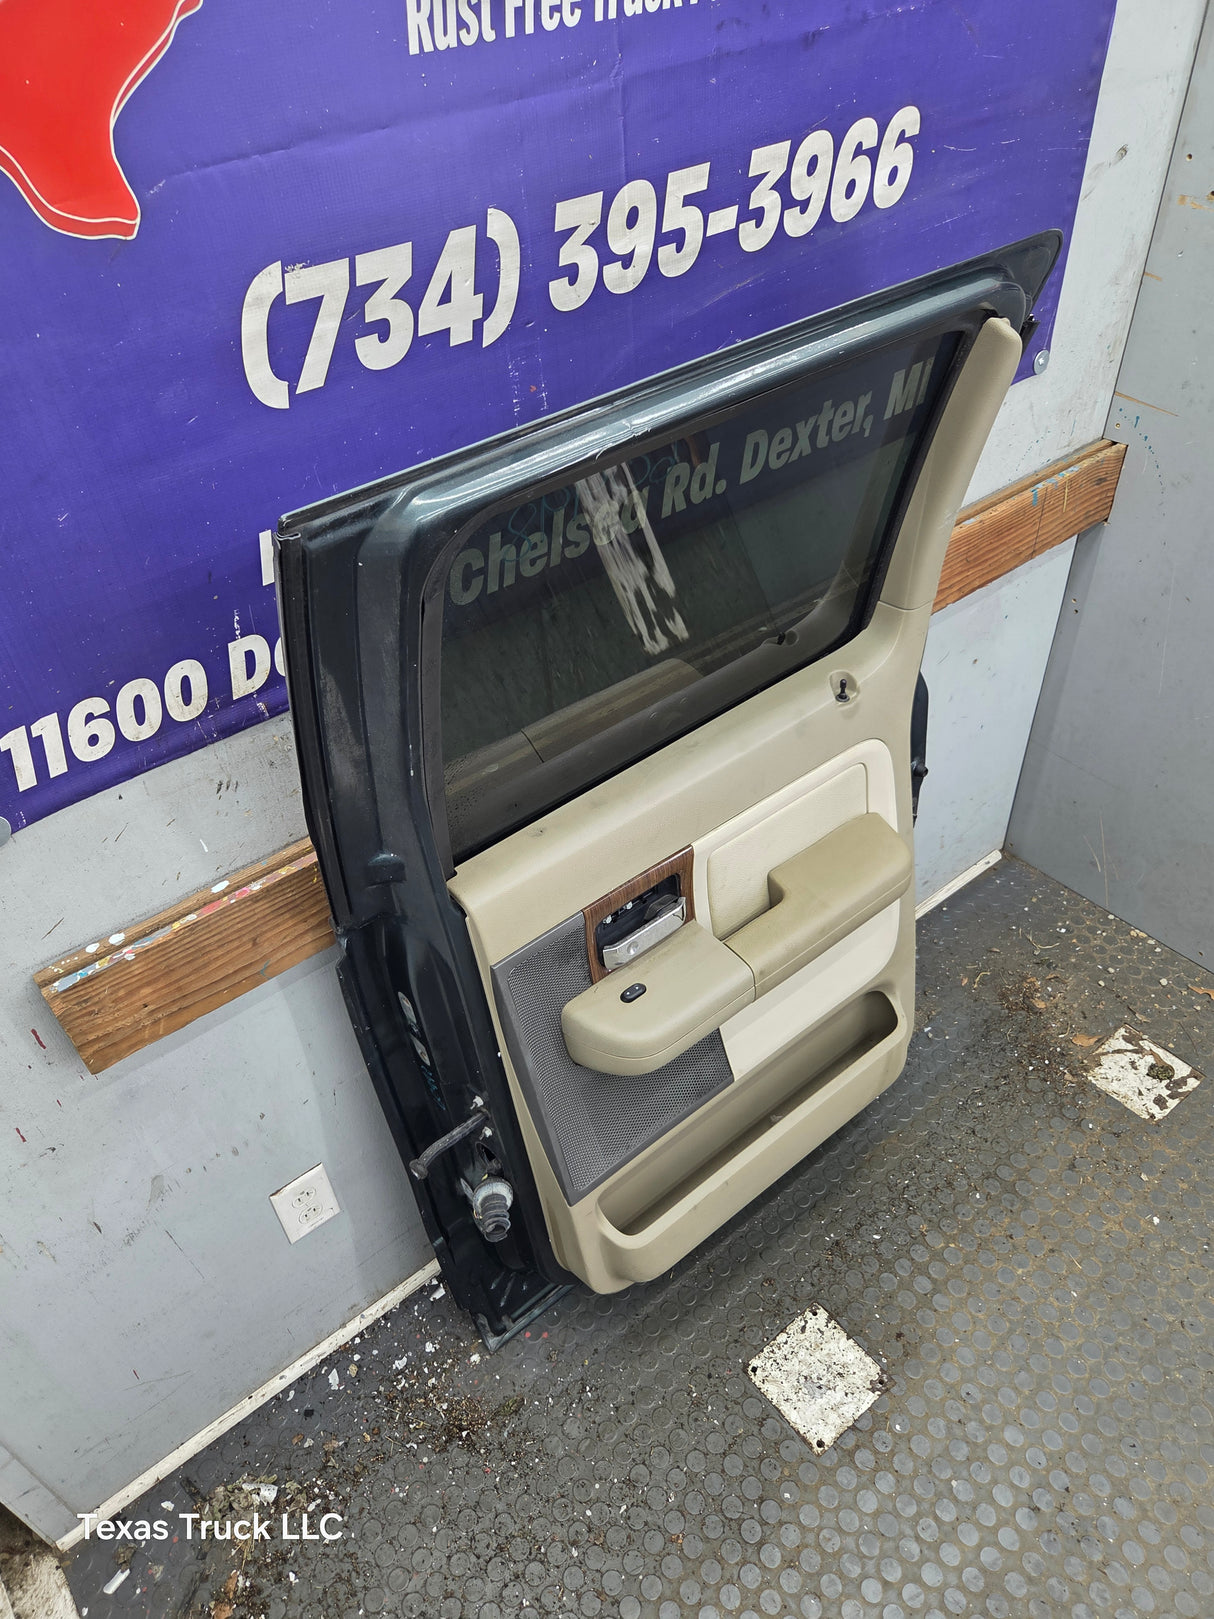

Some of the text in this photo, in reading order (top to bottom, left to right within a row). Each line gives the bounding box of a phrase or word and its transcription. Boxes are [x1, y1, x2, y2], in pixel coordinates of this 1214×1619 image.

[240, 107, 921, 410] (734) 395-3966
[0, 659, 209, 793] 11600
[449, 489, 648, 607] Chelsea
[660, 444, 728, 519] Rd.
[740, 390, 874, 480] Dexter,
[883, 356, 935, 421] MI
